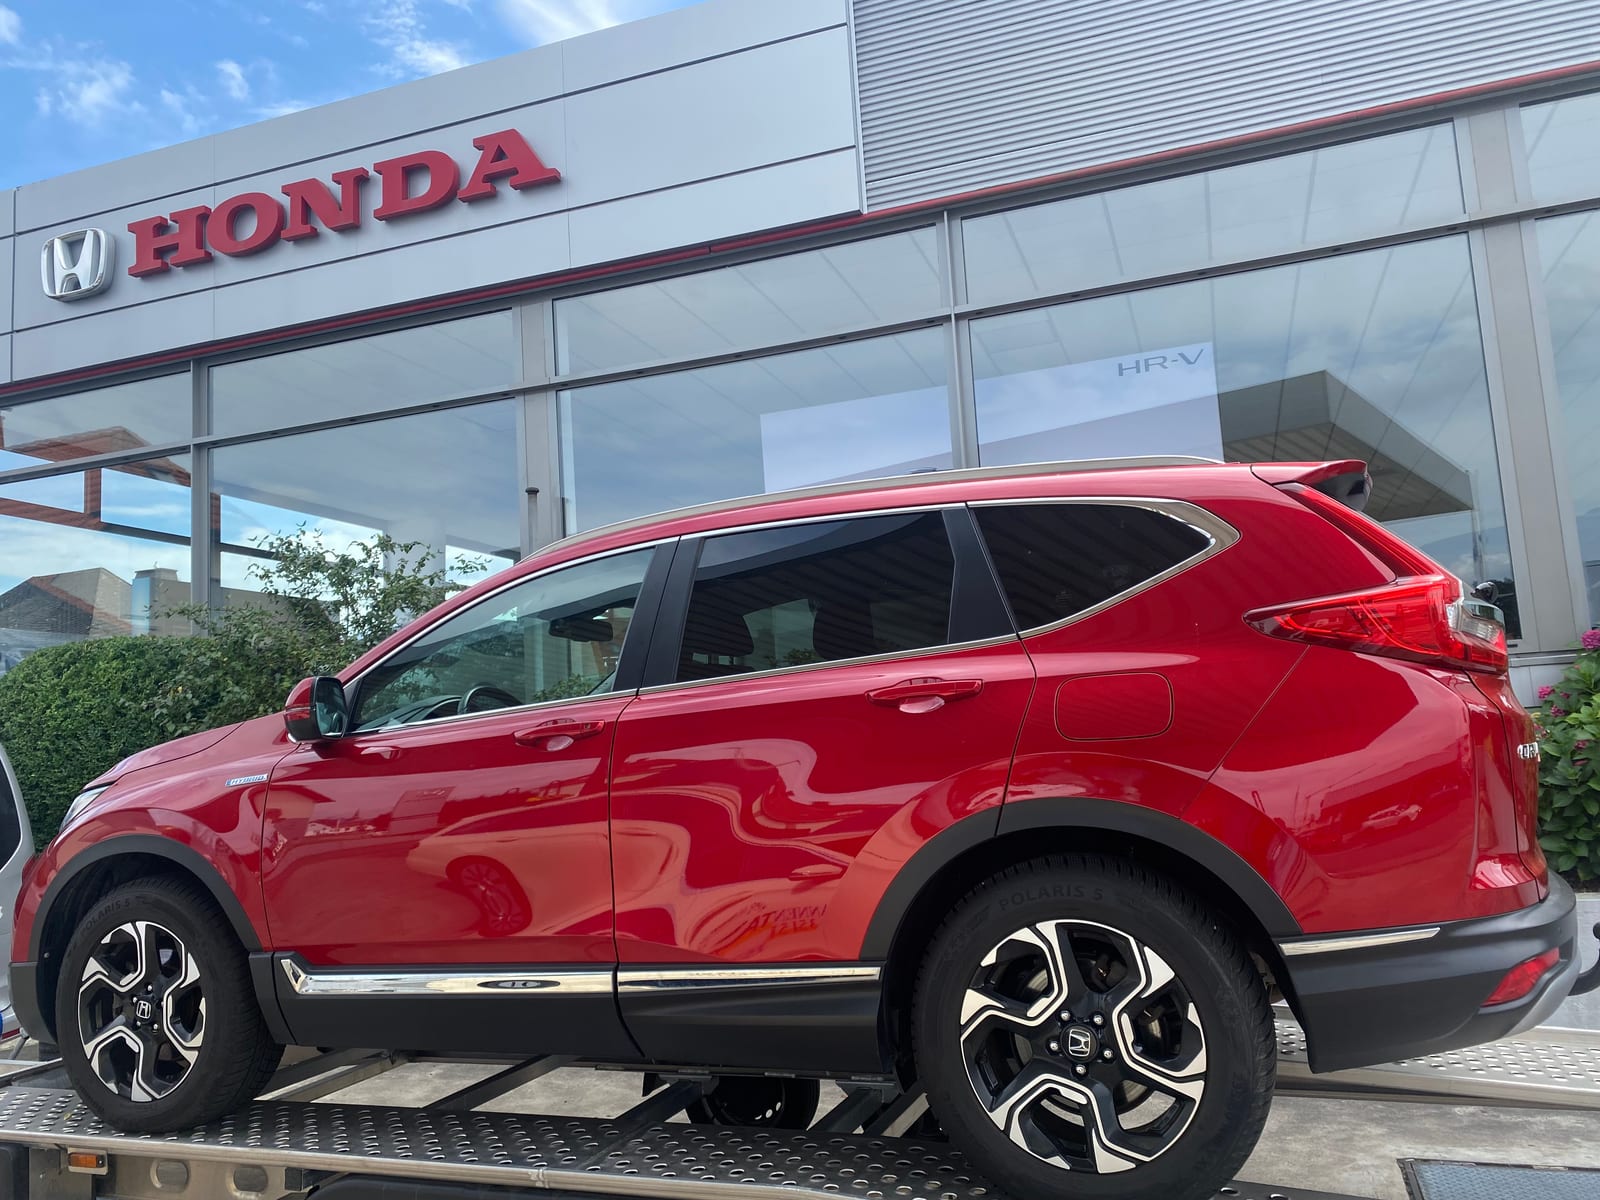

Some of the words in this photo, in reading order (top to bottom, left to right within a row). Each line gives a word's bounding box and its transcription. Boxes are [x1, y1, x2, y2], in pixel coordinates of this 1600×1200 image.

[127, 127, 562, 278] HONDA
[1118, 348, 1204, 377] HR-V
[998, 883, 1085, 912] POLARIS
